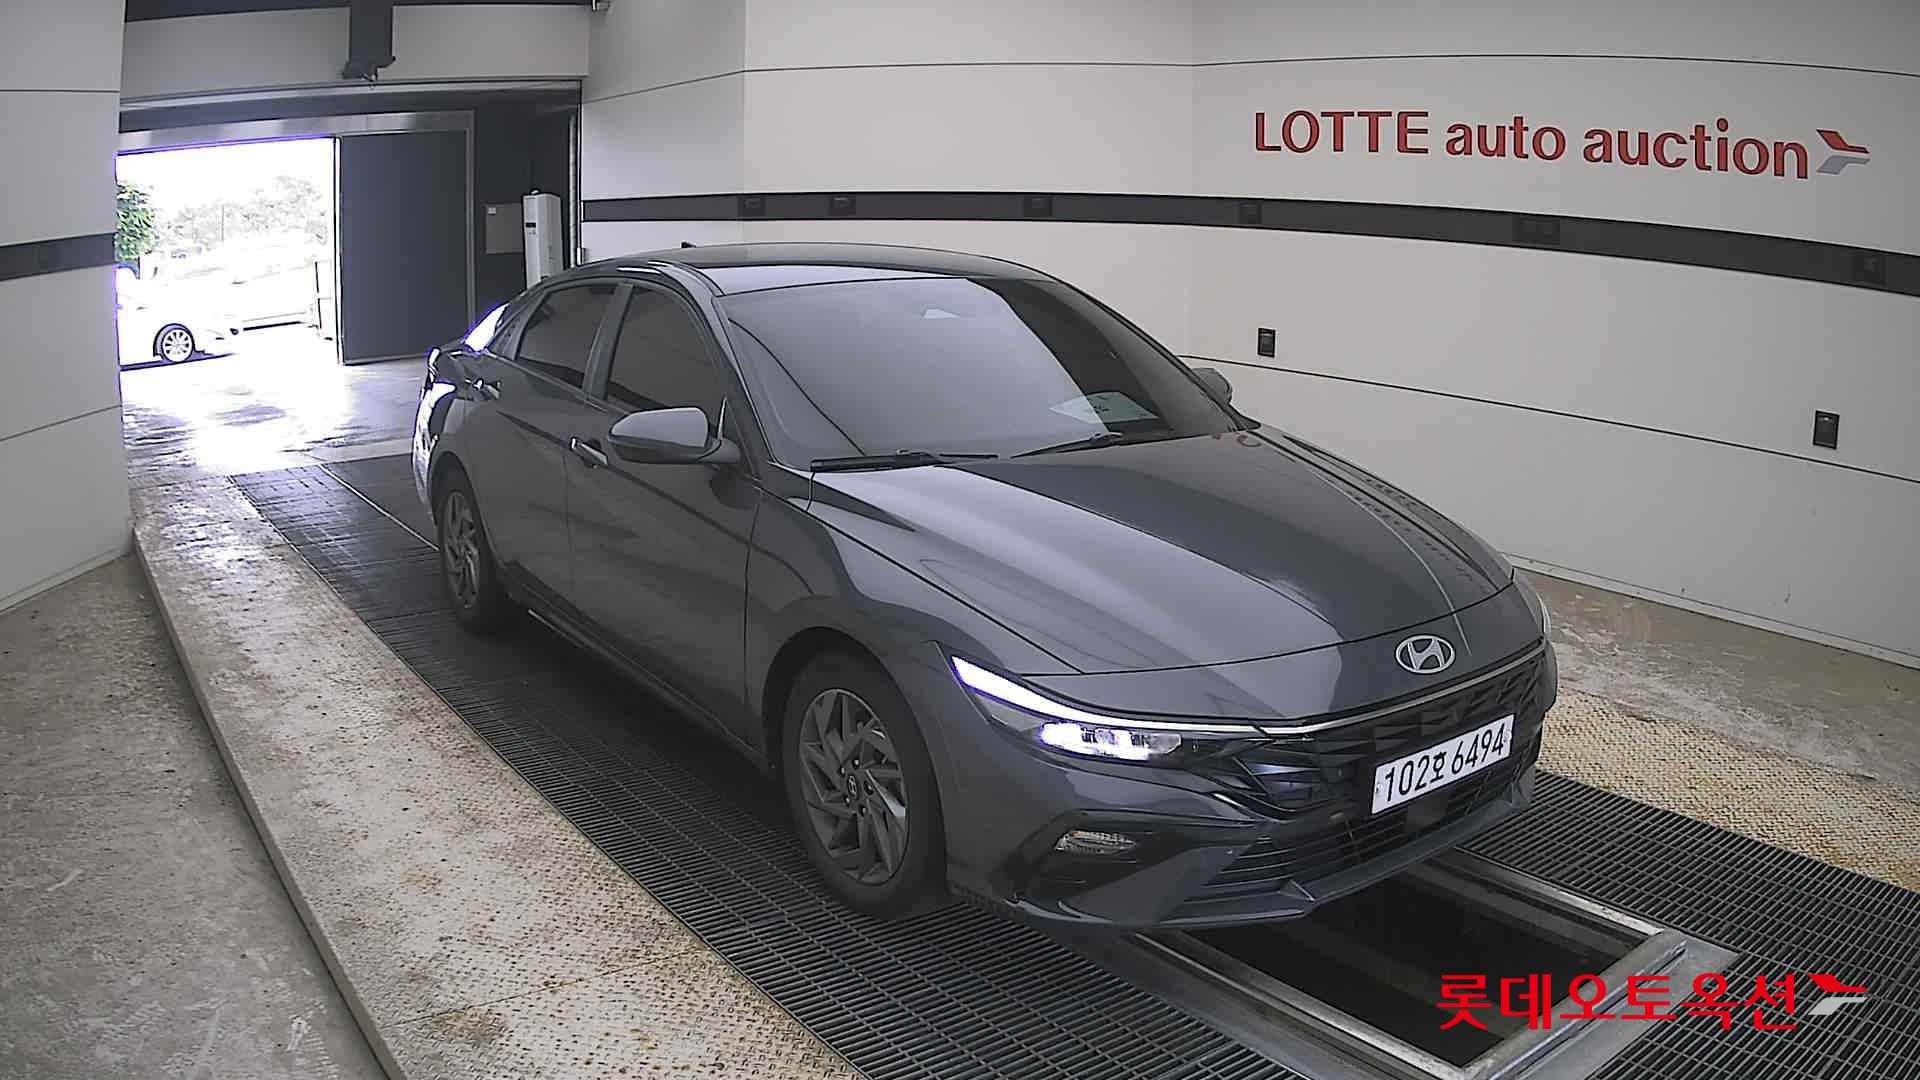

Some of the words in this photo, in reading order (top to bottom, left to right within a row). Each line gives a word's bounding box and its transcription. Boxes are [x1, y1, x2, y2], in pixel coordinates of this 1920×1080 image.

[1255, 110, 1429, 154] LOTTE
[1446, 115, 1567, 161] auto
[1583, 118, 1809, 179] auction
[1385, 750, 1447, 802] 102호
[1451, 722, 1505, 775] 6494
